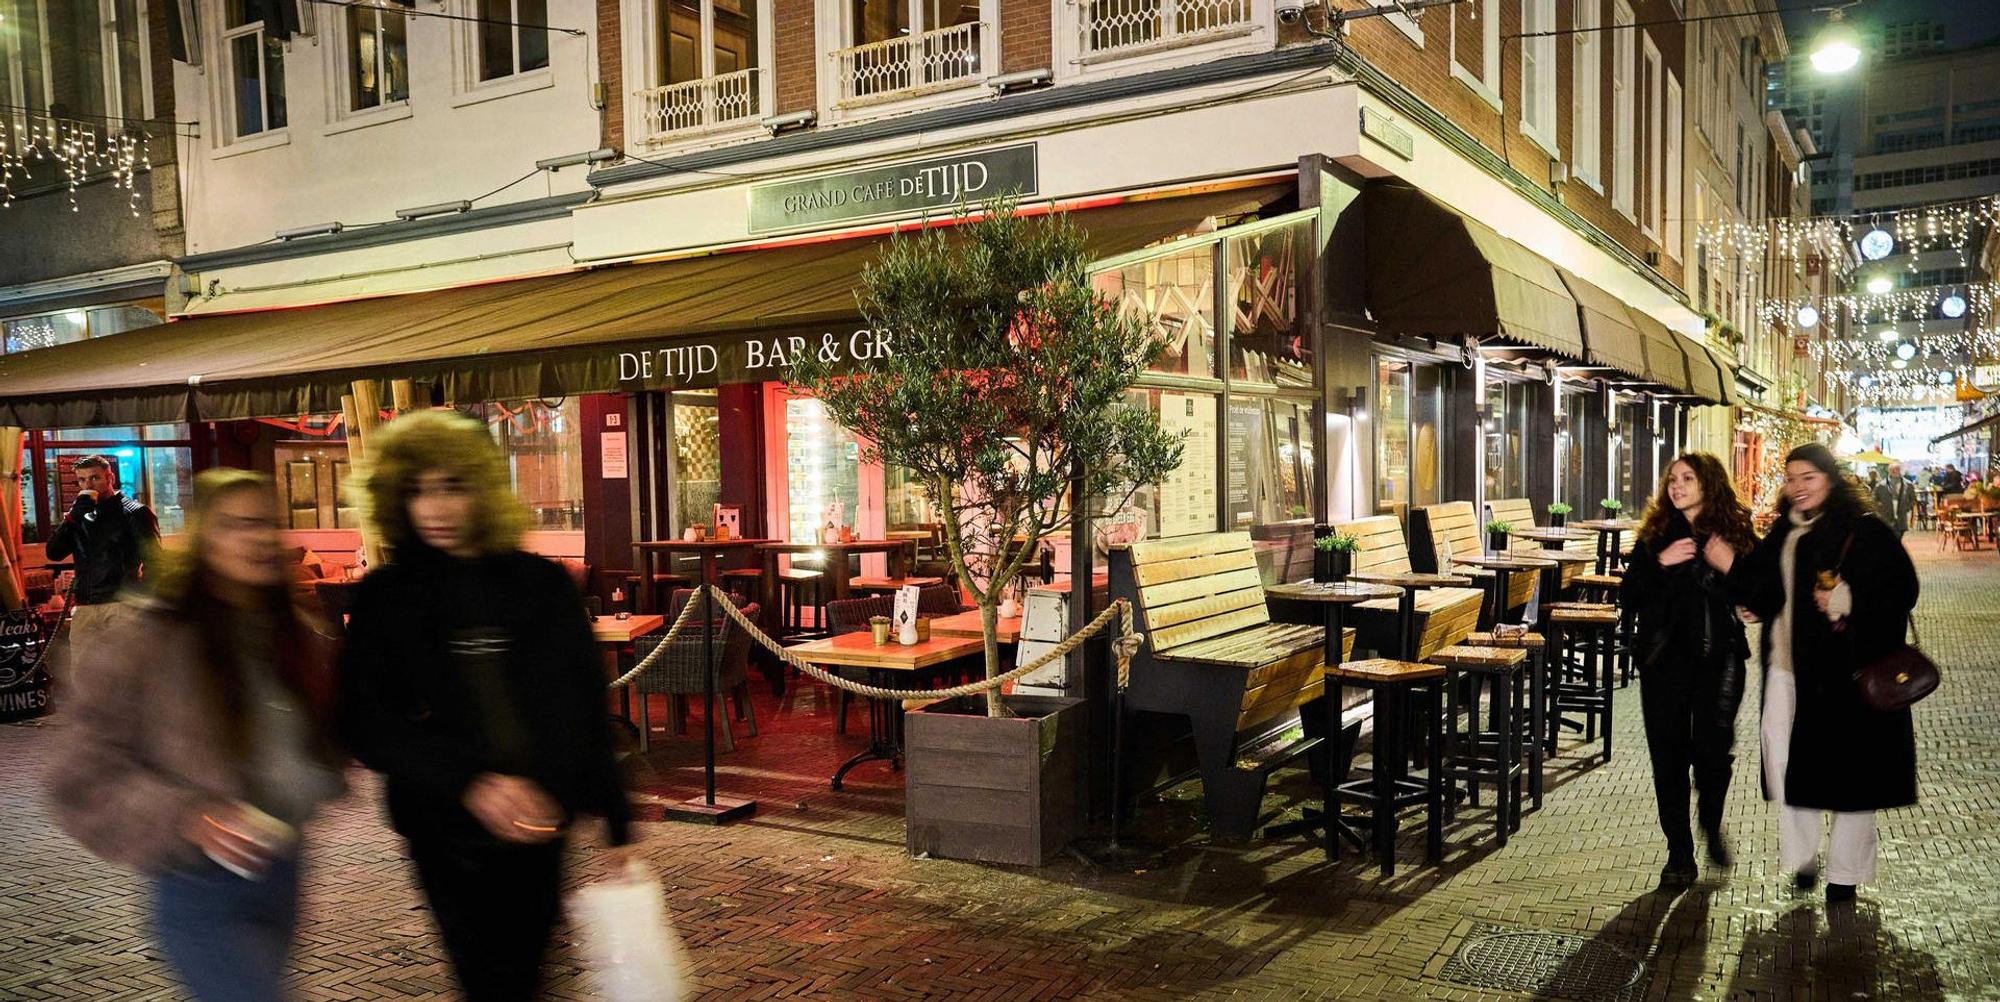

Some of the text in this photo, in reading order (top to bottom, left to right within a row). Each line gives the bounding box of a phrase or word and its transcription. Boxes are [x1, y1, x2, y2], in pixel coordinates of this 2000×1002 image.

[784, 189, 847, 213] GRAND
[851, 177, 895, 203] CAFÉ
[619, 344, 717, 384] DE TIJD
[745, 336, 808, 369] BAR
[818, 332, 841, 363] &
